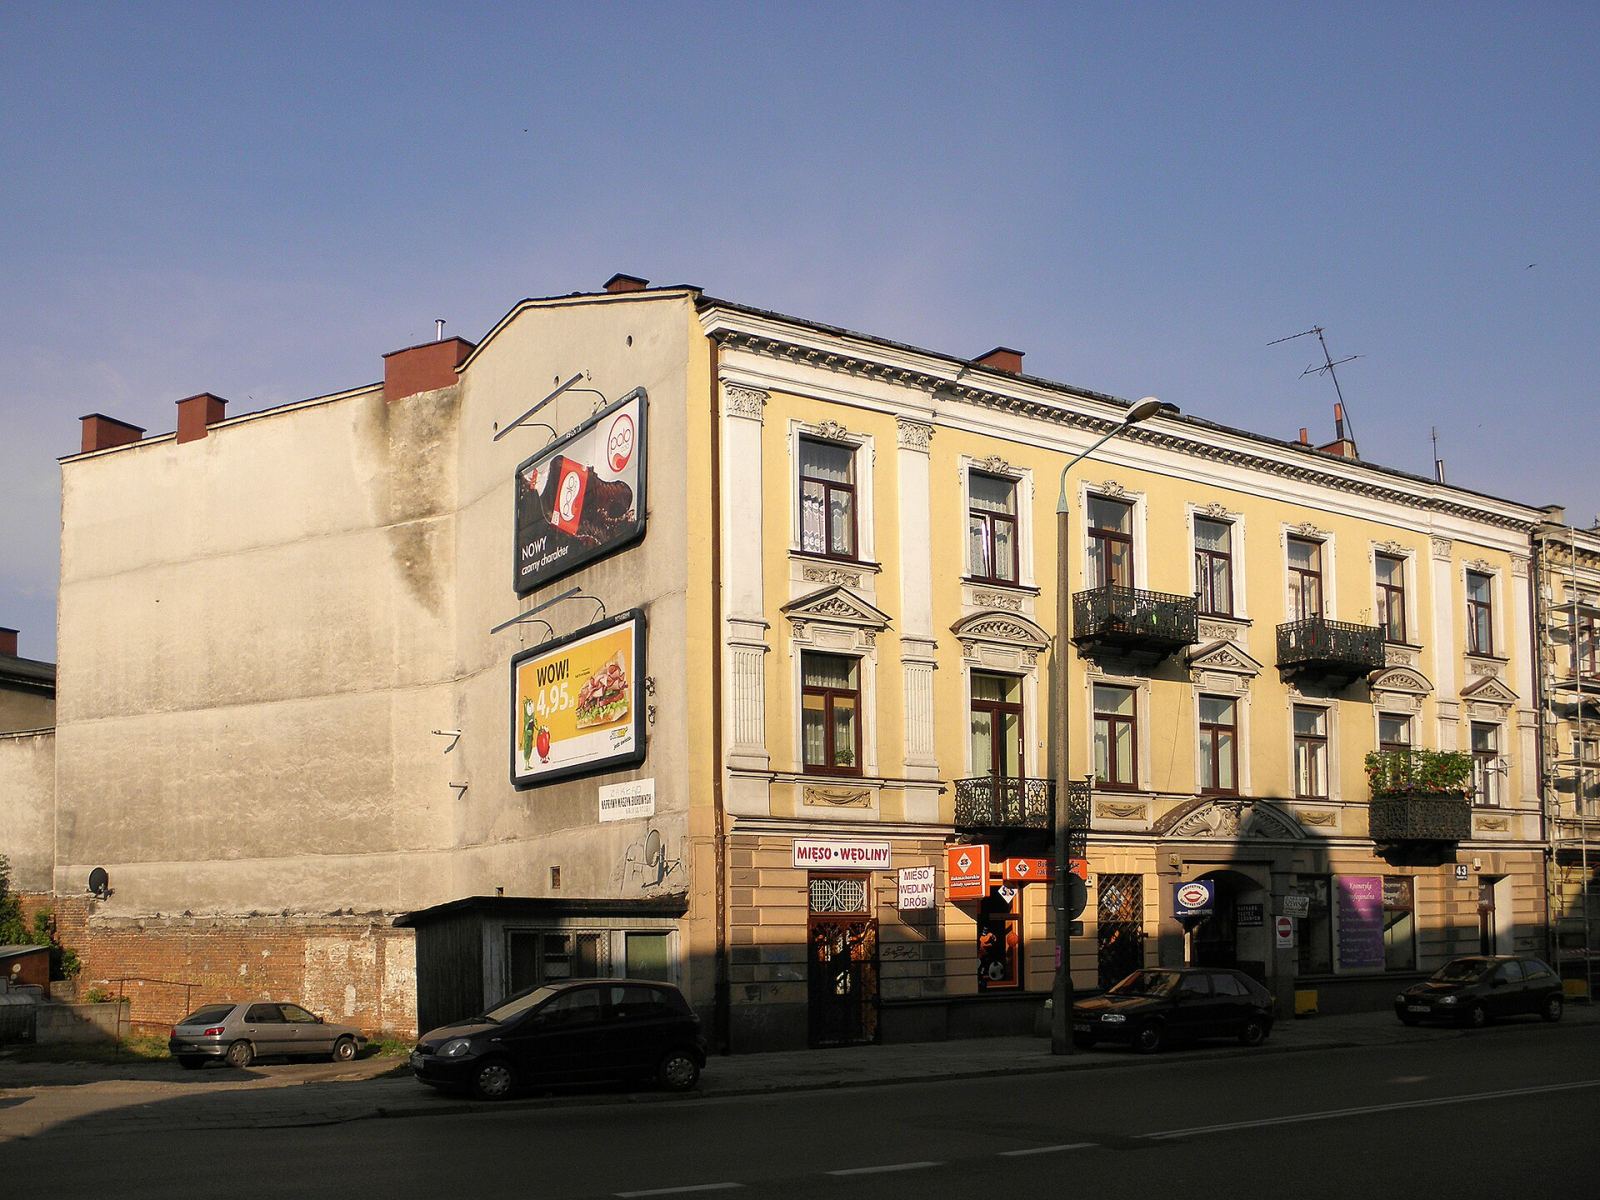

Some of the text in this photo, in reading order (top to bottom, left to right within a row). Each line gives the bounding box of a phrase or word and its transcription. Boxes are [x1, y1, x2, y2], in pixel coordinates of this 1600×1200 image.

[521, 535, 547, 561] NOWY
[540, 545, 569, 567] charakter
[536, 658, 569, 687] WOW!
[536, 682, 569, 718] 4,95
[797, 847, 888, 863] MIĘSO WĘDLINY
[1456, 865, 1467, 876] 43
[903, 895, 927, 907] DRÓB
